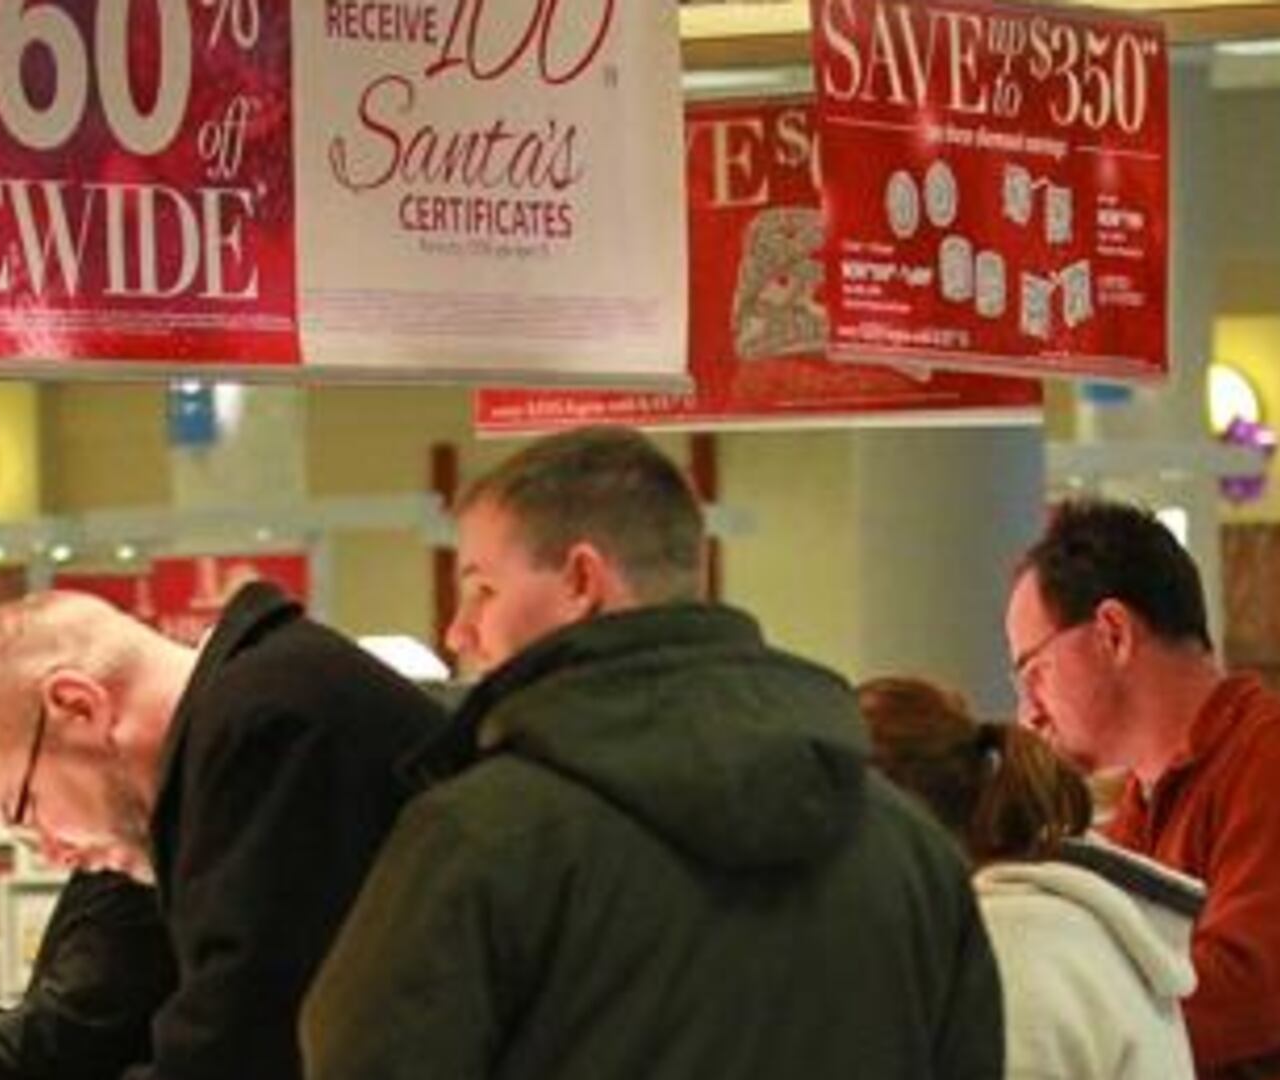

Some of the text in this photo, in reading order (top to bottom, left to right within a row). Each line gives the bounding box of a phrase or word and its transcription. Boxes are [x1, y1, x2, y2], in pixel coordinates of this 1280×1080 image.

[325, 0, 438, 43] RECEIVE
[822, 0, 988, 114] SAVE
[992, 74, 1021, 118] to
[199, 97, 255, 178] off
[327, 74, 584, 192] Santa's
[398, 195, 573, 239] CERTIFICATES
